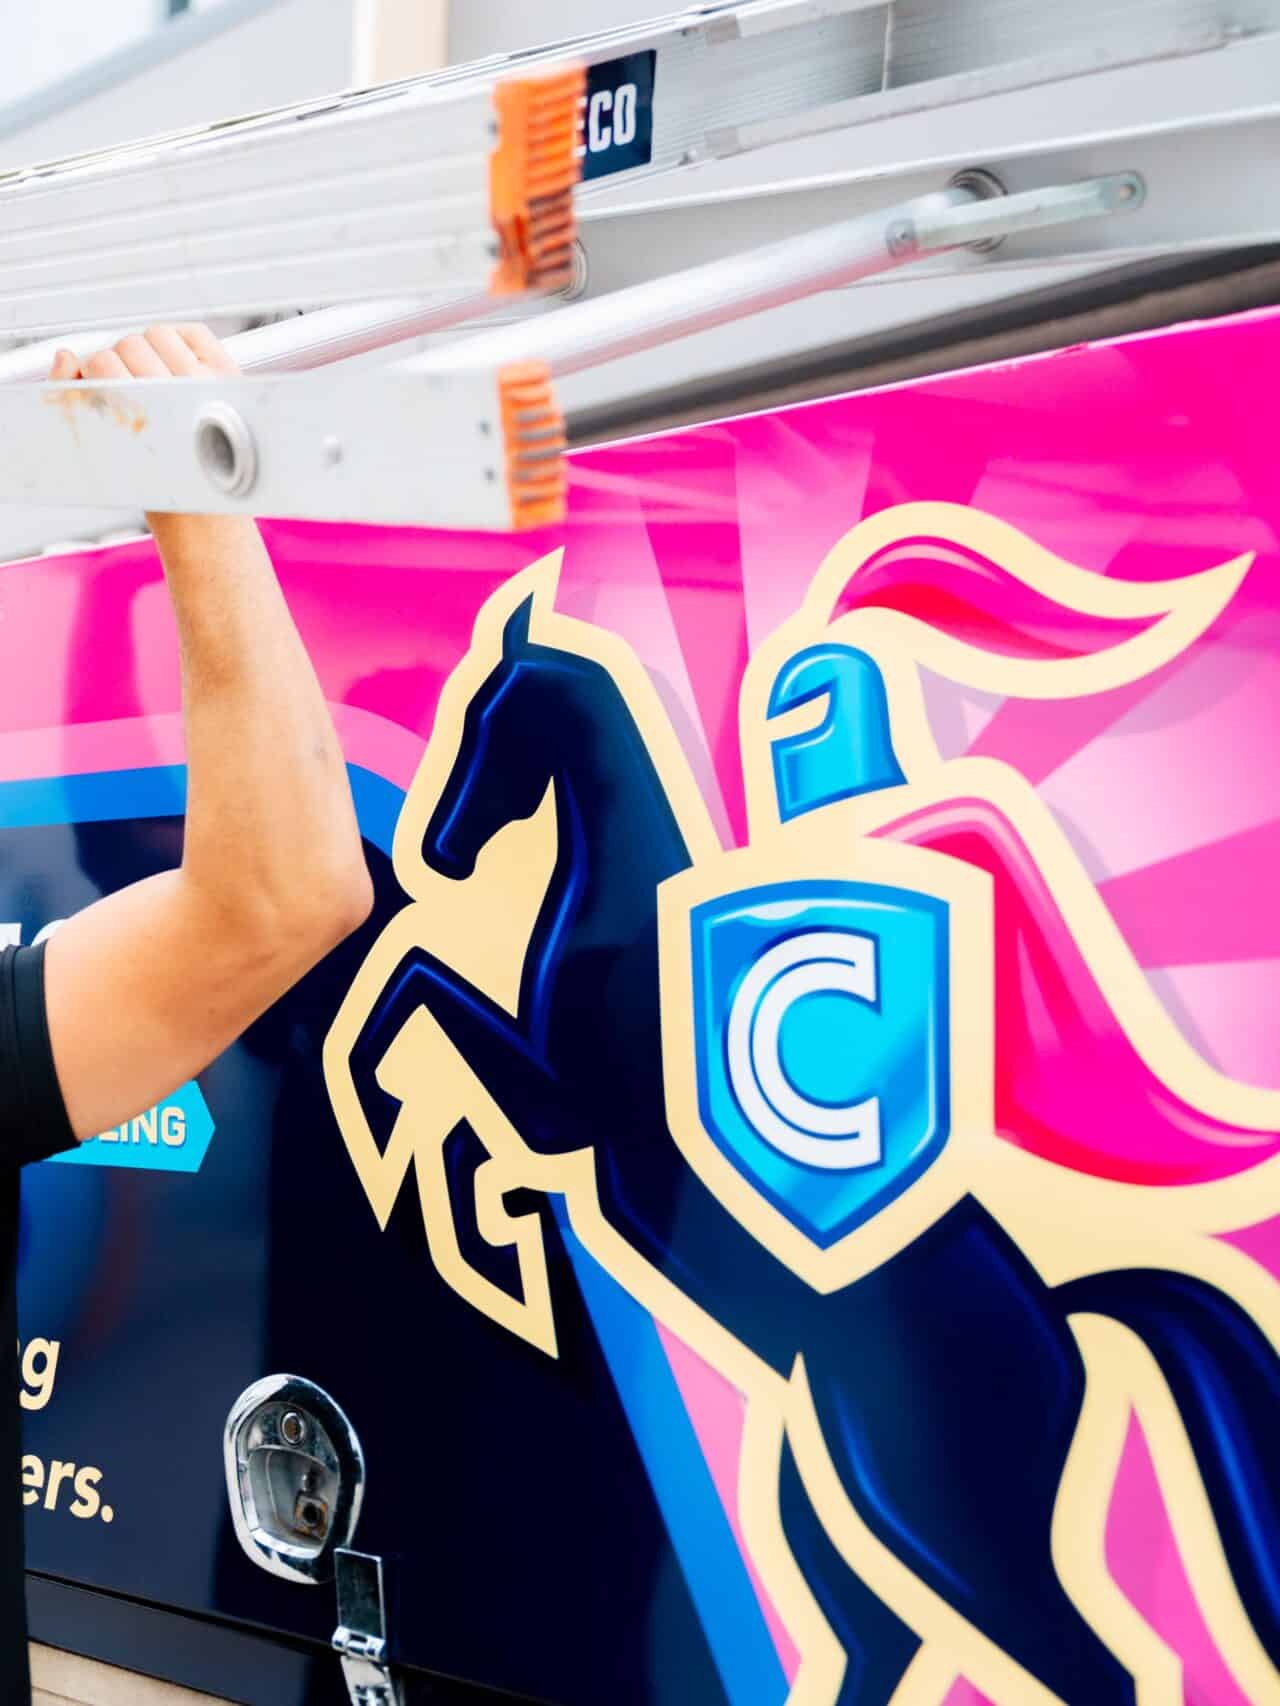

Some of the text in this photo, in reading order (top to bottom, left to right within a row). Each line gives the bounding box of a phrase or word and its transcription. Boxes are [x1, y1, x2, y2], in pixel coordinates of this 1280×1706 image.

[727, 930, 883, 1170] C
[97, 1106, 187, 1147] ING
[17, 1336, 61, 1411] g
